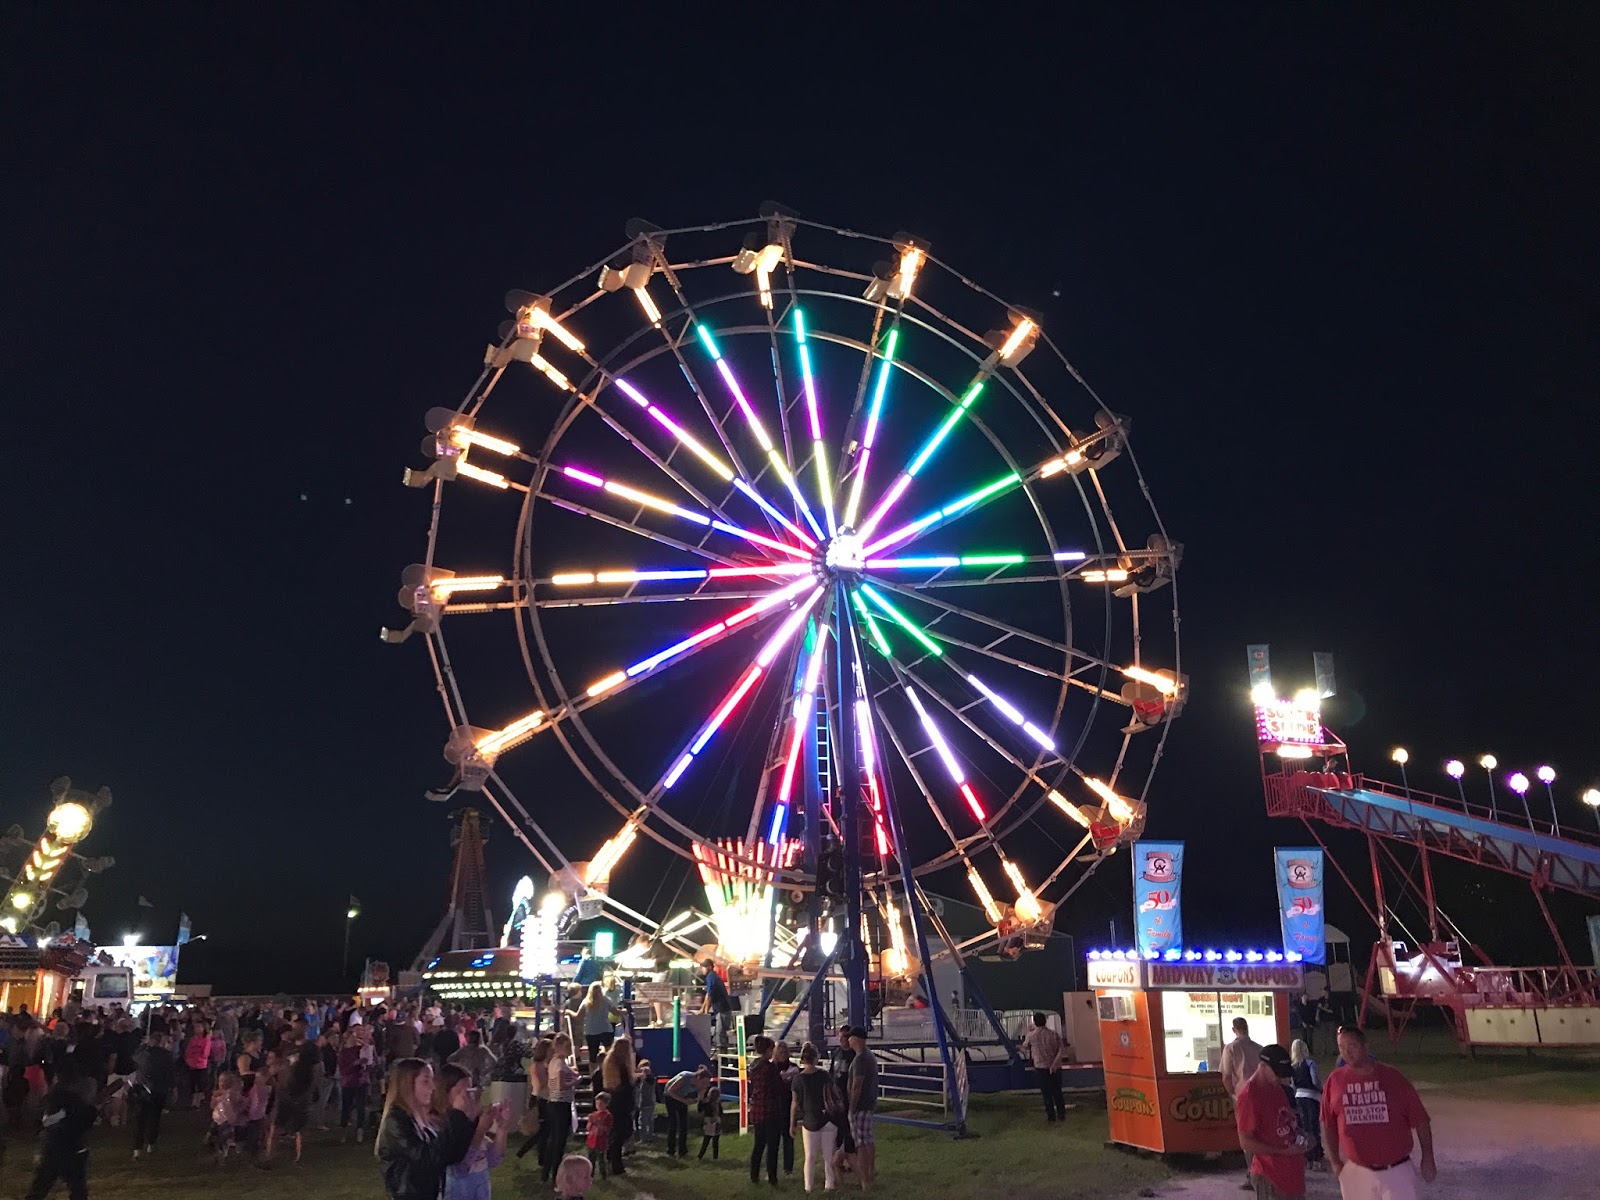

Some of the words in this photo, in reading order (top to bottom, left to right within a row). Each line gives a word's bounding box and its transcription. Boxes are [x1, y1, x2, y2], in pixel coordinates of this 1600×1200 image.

[1266, 707, 1317, 721] SUR
[1147, 890, 1171, 909] 50
[1293, 897, 1313, 914] 50
[1095, 966, 1135, 984] COUPONS
[1152, 965, 1215, 986] MIDWAY
[1237, 966, 1300, 986] COUPONS
[1347, 1083, 1361, 1093] DO
[1364, 1081, 1379, 1092] ME
[1113, 1097, 1155, 1116] COUPONS
[1343, 1094, 1349, 1105] A
[1352, 1091, 1386, 1105] FAVOR
